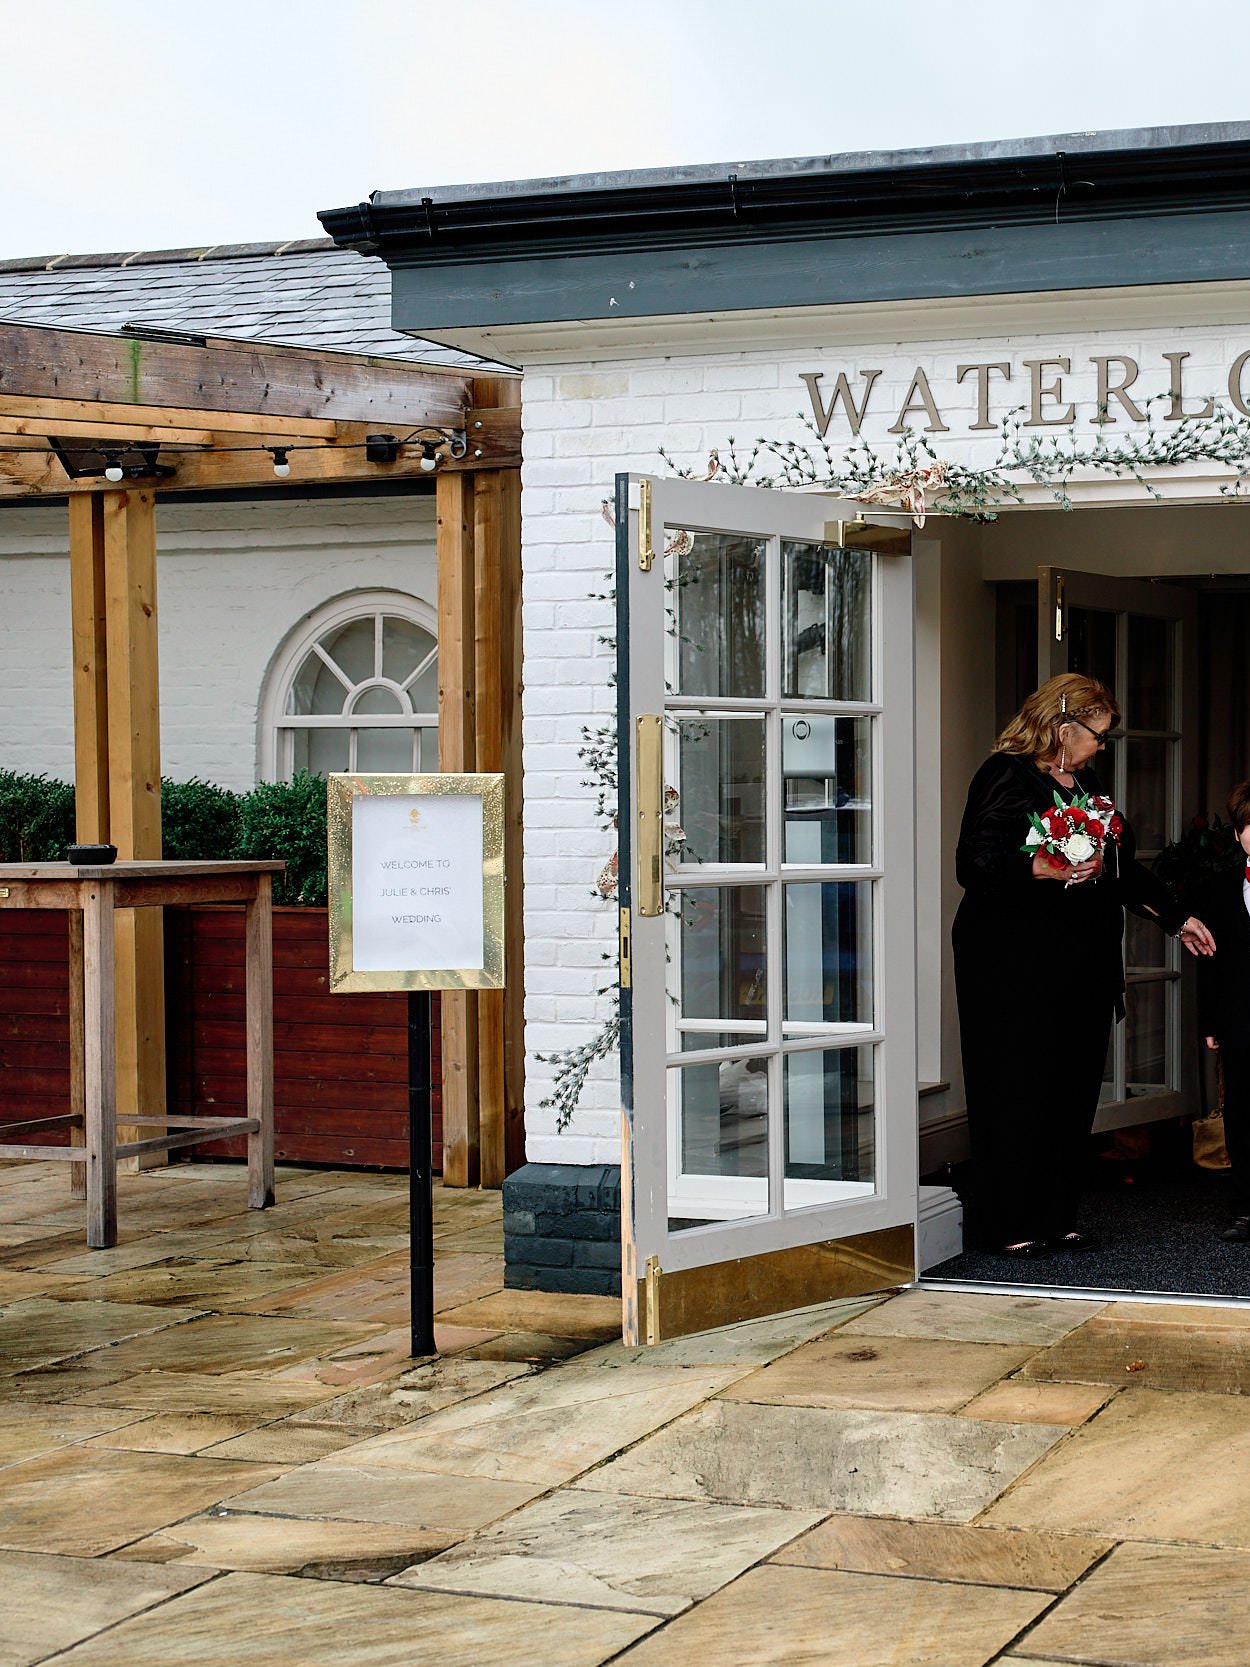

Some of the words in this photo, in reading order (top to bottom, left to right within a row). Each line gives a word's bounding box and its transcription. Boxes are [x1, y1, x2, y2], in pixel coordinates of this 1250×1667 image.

[380, 859, 434, 870] WELCOME
[435, 859, 451, 869] TO
[380, 887, 408, 897] JULIE
[410, 887, 417, 896] &
[391, 914, 442, 924] WEDDING
